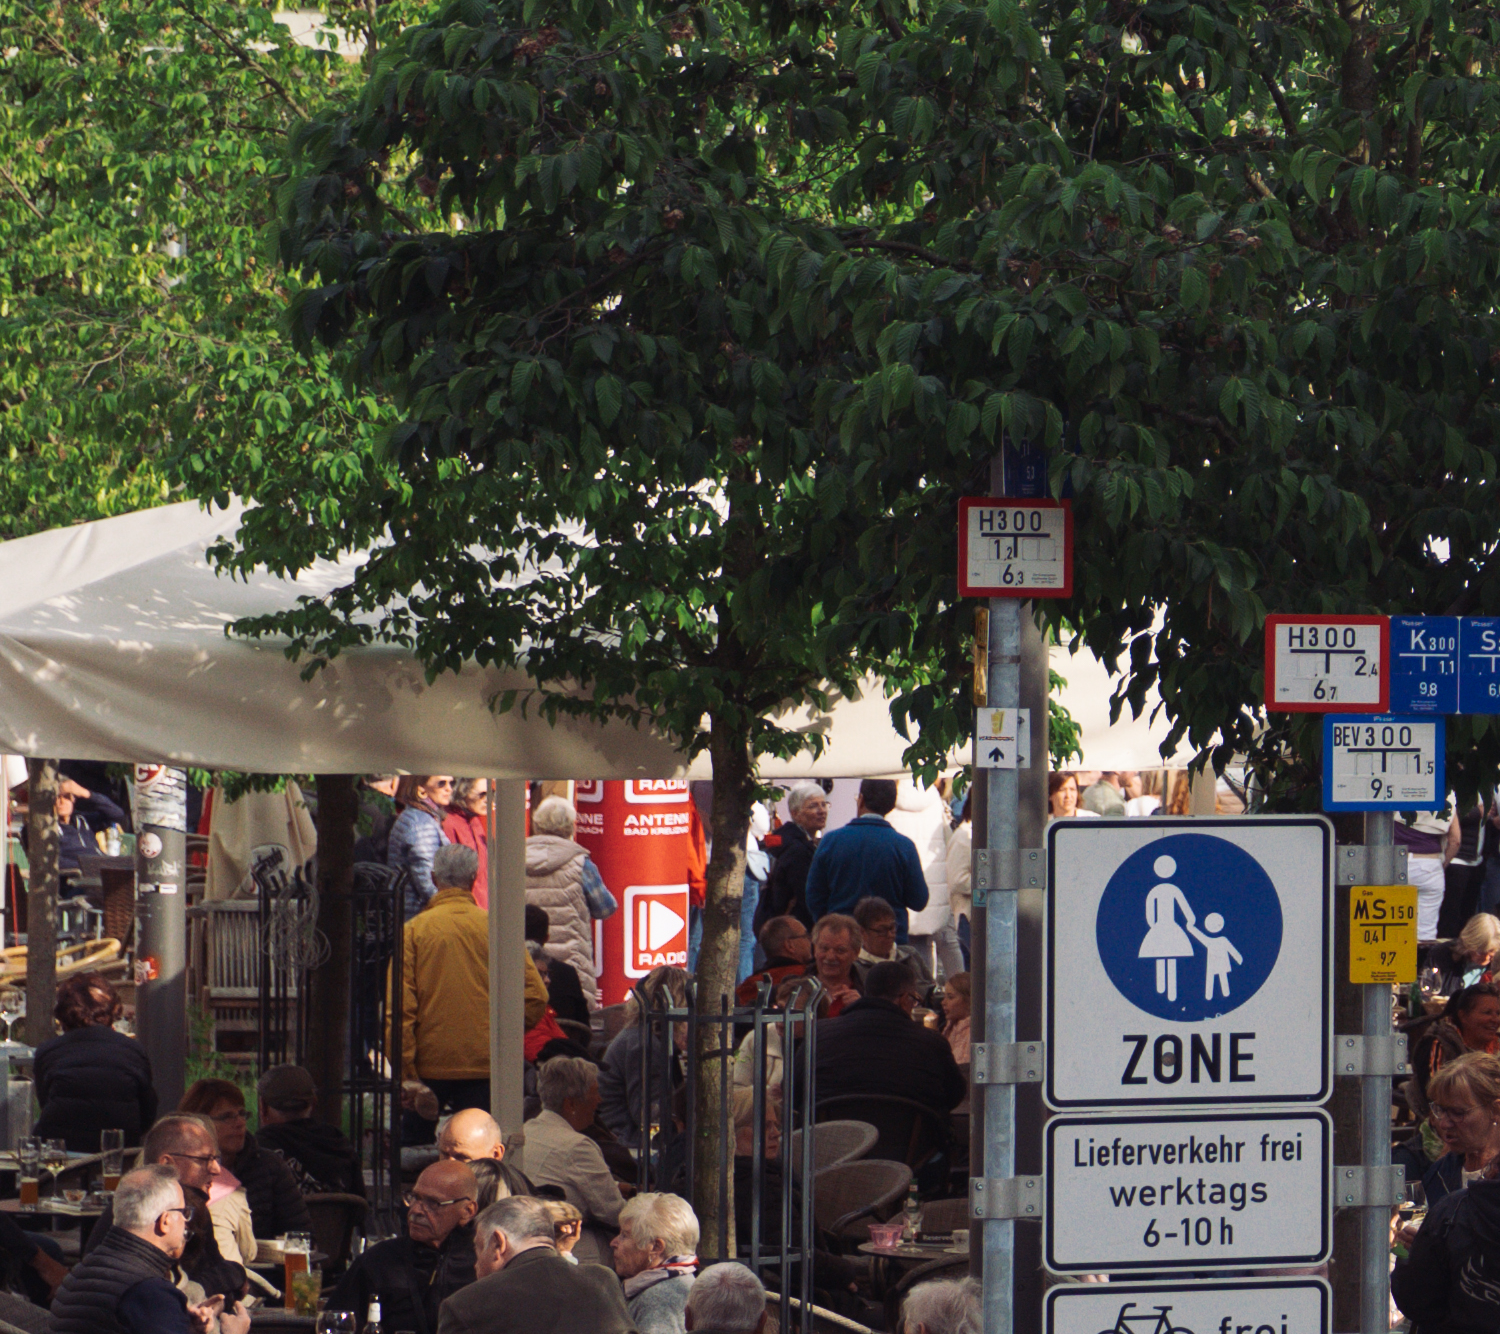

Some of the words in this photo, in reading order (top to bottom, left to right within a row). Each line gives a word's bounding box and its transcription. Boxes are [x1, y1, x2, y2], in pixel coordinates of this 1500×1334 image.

[994, 539, 1013, 561] 1,2
[1002, 563, 1024, 586] 6,3
[1354, 656, 1379, 678] 2,4
[1439, 661, 1455, 676] 1,1
[1313, 679, 1338, 701] 6,7
[1419, 682, 1438, 697] 9,8
[1413, 754, 1434, 776] 1,5
[1371, 778, 1393, 801] 9,5
[624, 813, 689, 827] ANTENN
[623, 827, 649, 836] BAD
[1364, 930, 1379, 945] 0,4
[1381, 951, 1397, 966] 9,7
[1121, 1032, 1256, 1085] ZONE
[1074, 1134, 1246, 1168] Lieferverkehr
[1260, 1132, 1302, 1162] frei
[1109, 1176, 1268, 1212] werktags
[1143, 1217, 1212, 1248] 6-10
[1220, 1216, 1233, 1245] h
